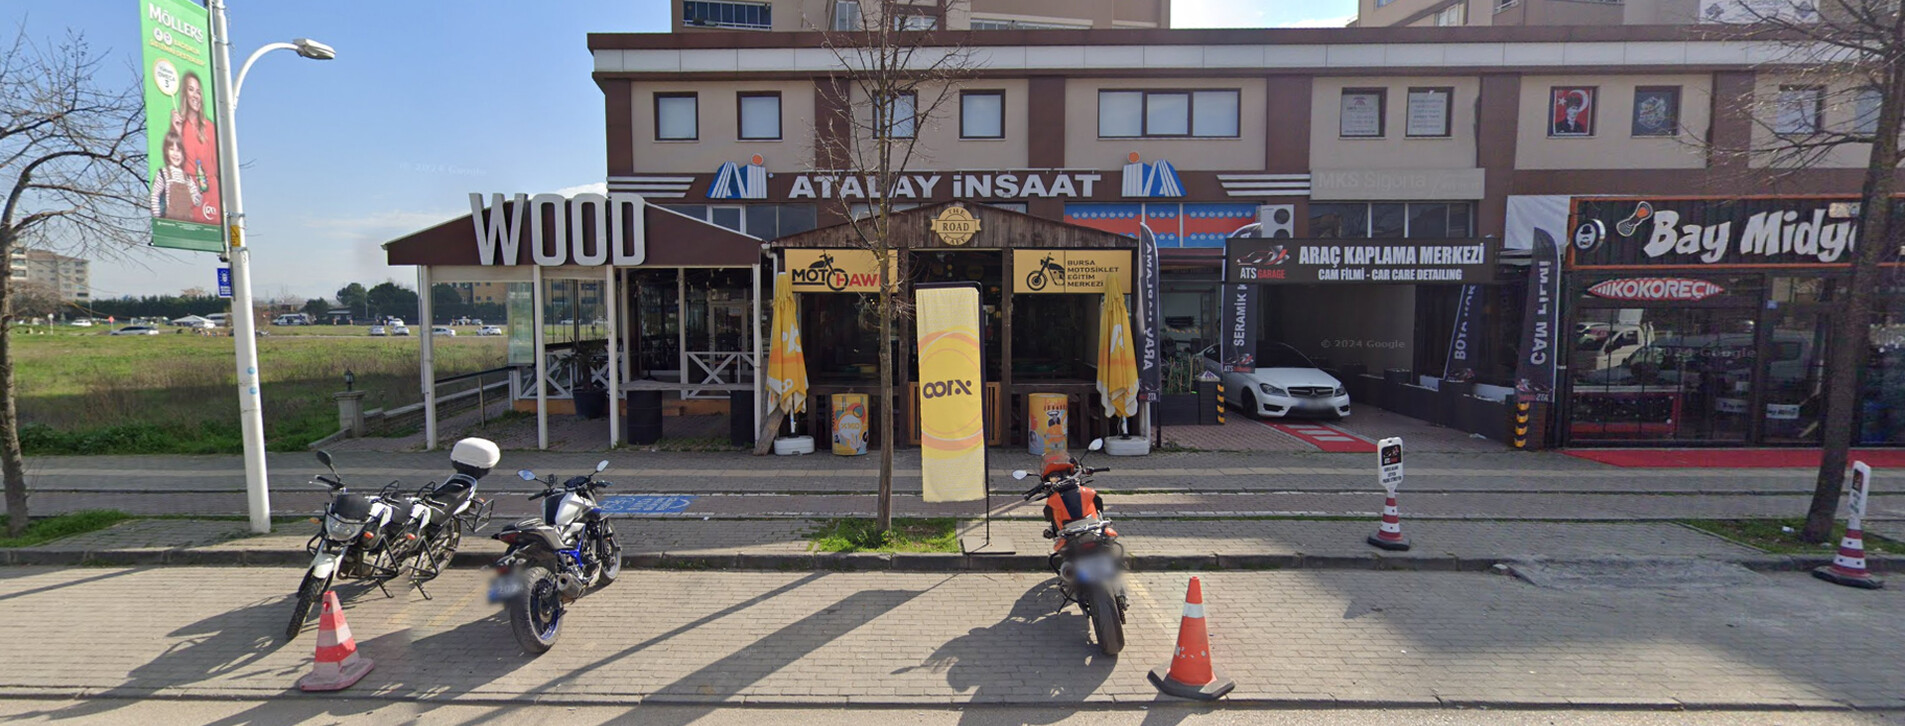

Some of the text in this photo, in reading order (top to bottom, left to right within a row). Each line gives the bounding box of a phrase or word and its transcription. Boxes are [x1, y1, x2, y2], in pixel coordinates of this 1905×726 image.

[788, 175, 942, 199] ATALAY
[1318, 172, 1358, 189] MKS
[1363, 171, 1427, 192] Sigorta
[948, 208, 966, 216] THE
[469, 192, 645, 266] WOOD
[942, 222, 970, 232] ROAD
[1643, 210, 1732, 264] Bay
[1299, 242, 1485, 269] ARAÇ KAPLAMA MERKEZİ
[1240, 267, 1286, 279] ATS GARAGE
[1318, 269, 1340, 280] CAM
[1342, 267, 1365, 280] FİLMİ
[1371, 269, 1391, 280] CAR
[1392, 269, 1416, 280] CARE
[1417, 269, 1462, 280] DETAILING
[1610, 279, 1706, 299] KOKOREÇ
[1233, 291, 1248, 347] SERAMİK
